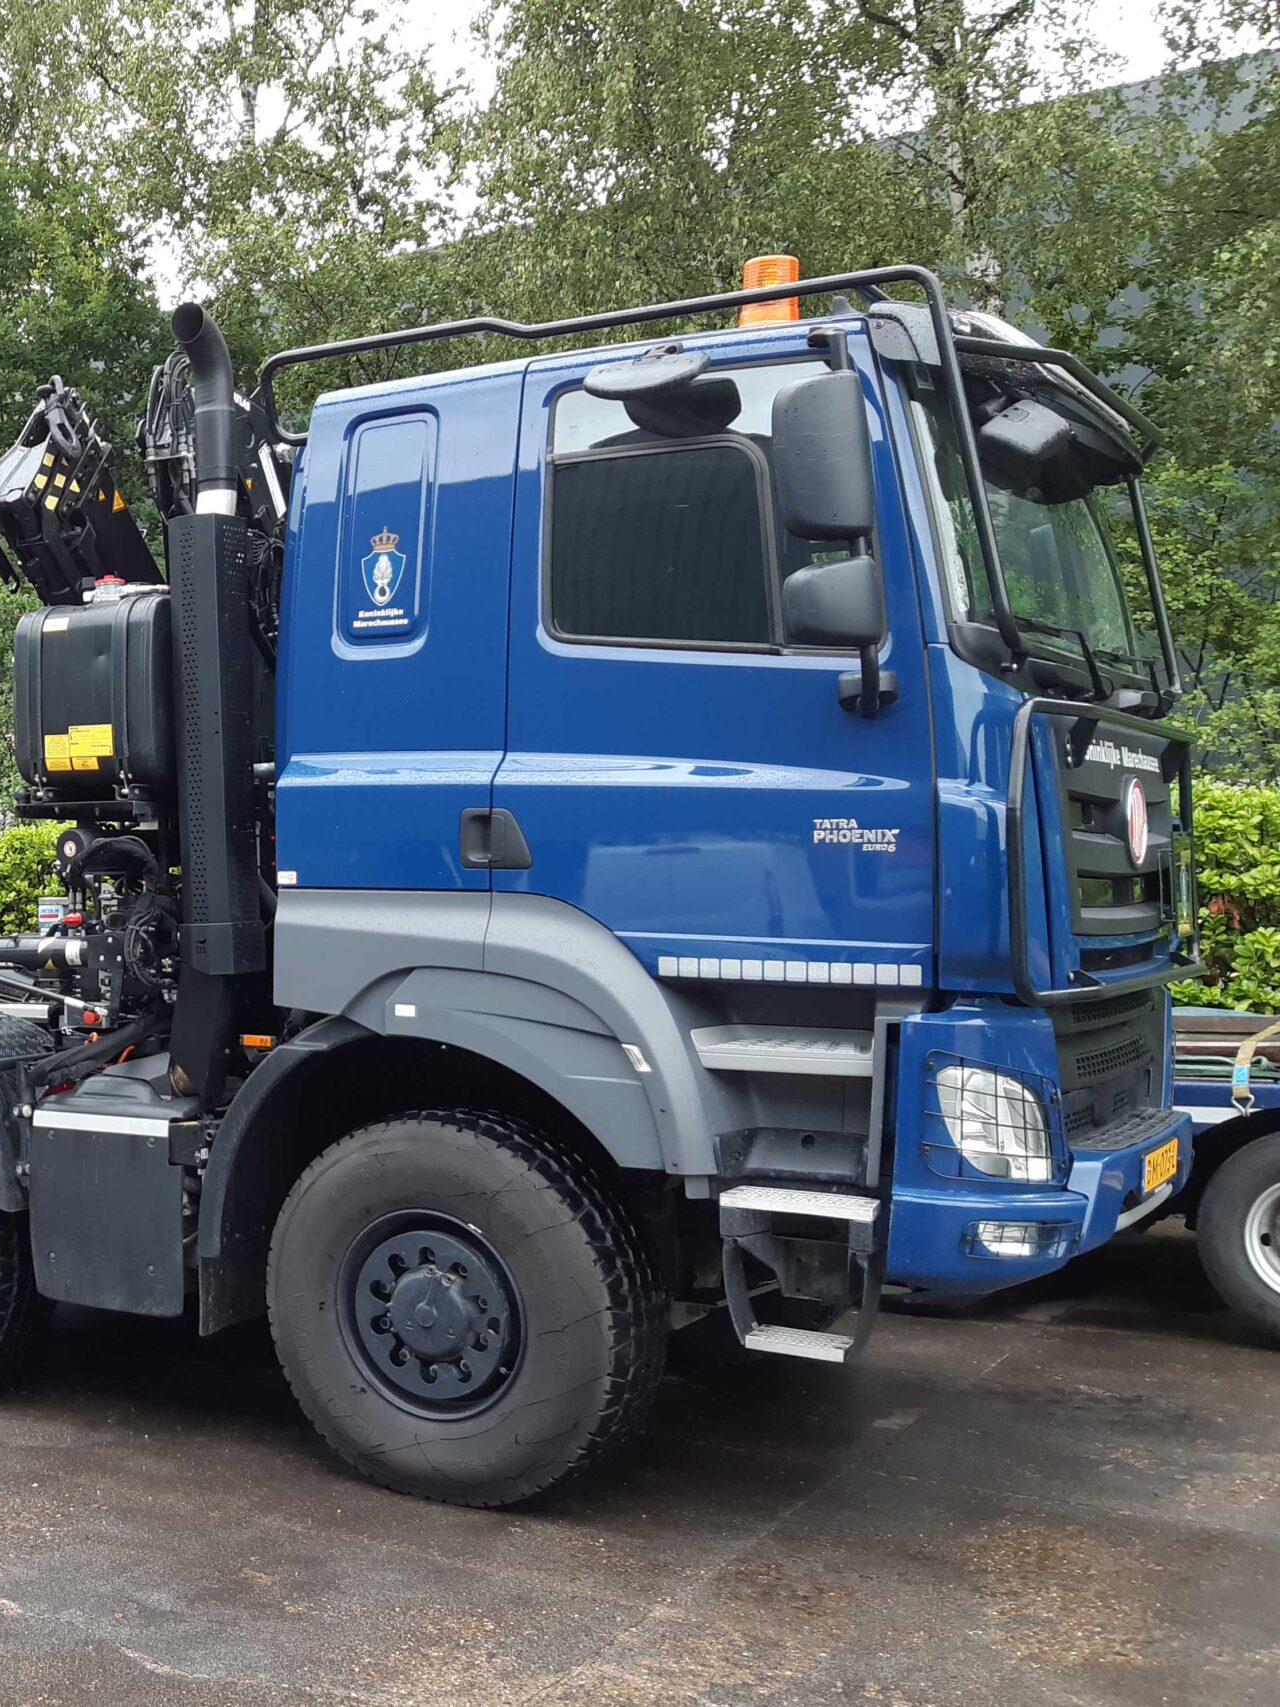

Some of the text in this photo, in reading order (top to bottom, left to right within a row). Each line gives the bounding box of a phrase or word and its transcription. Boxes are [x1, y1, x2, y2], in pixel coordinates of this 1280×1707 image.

[358, 608, 404, 618] Koninklijke
[352, 618, 409, 628] Marechaussee
[812, 818, 858, 829] TATRA
[813, 829, 900, 844] PHOENIX
